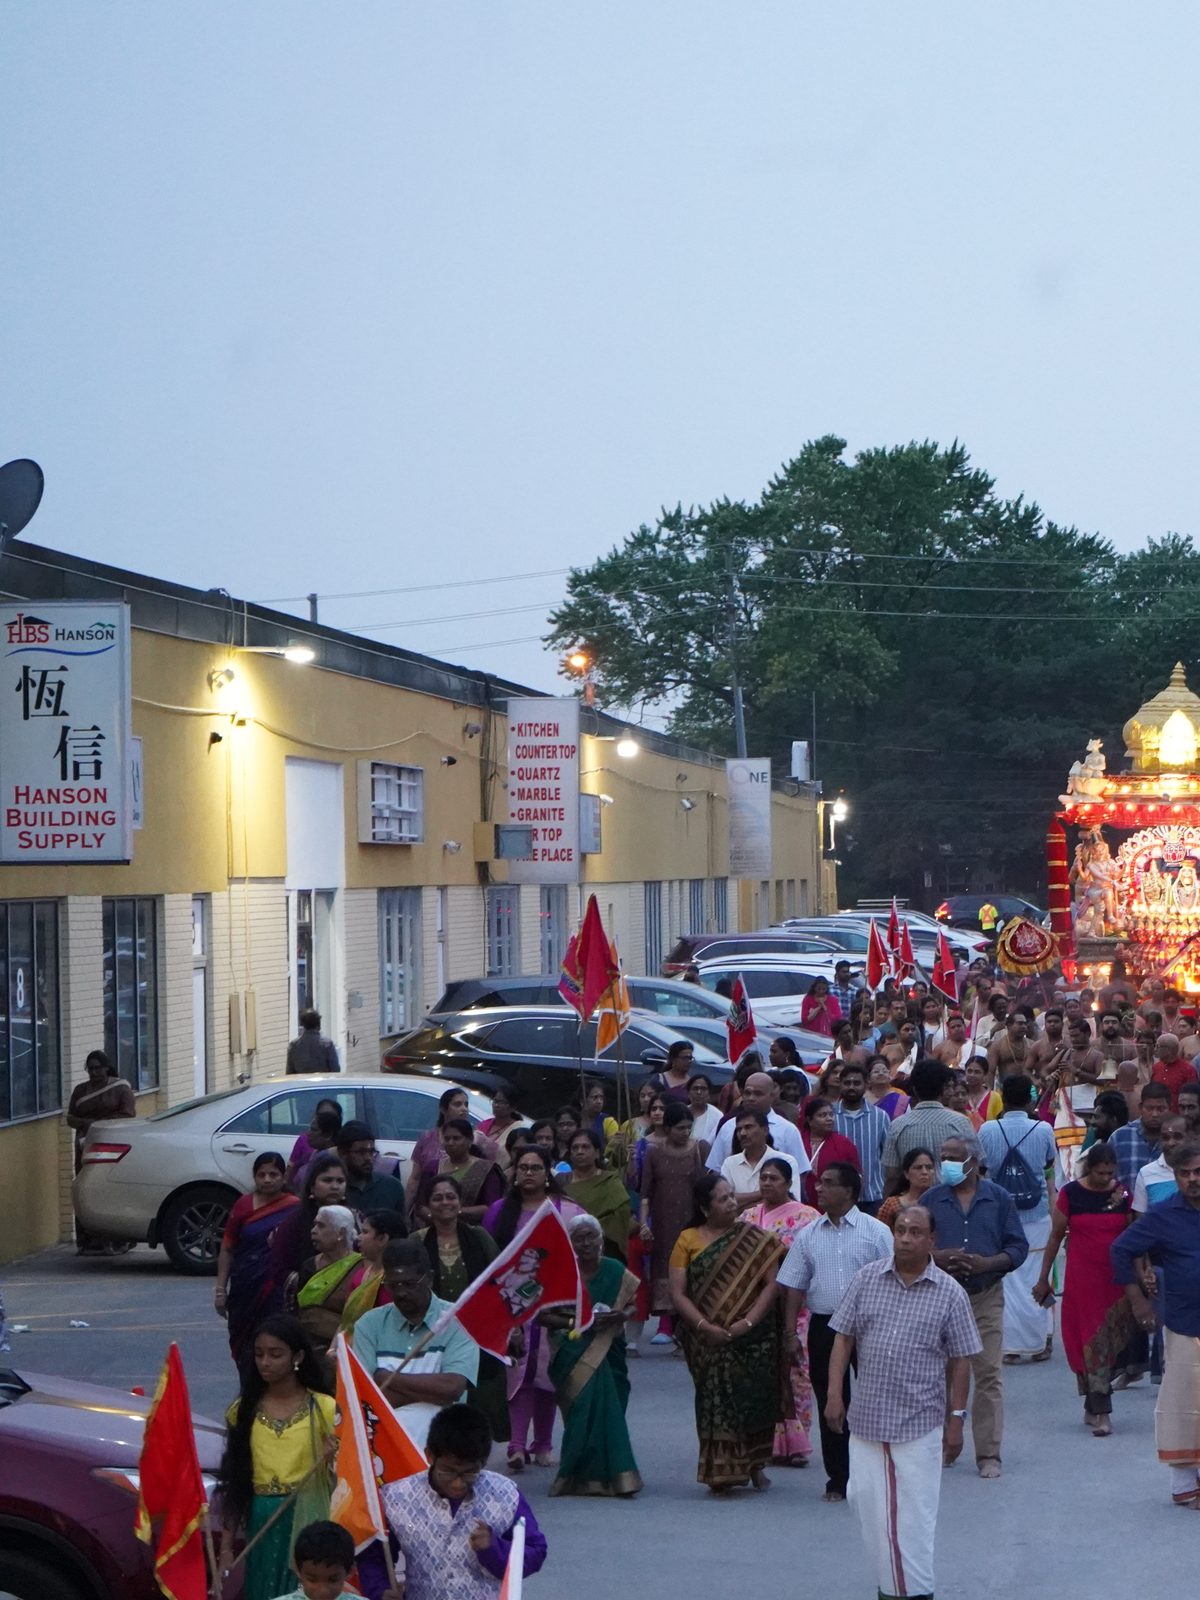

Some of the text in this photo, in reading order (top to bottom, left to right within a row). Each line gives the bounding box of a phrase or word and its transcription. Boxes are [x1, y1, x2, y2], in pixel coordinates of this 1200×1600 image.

[7, 613, 115, 644] HBS HANSON
[517, 723, 559, 737] KITCHEN
[515, 744, 576, 759] COUNTER TOP
[517, 767, 560, 780] QUARTZ
[14, 785, 108, 804] HANSON
[517, 788, 560, 800] MARBLE
[6, 808, 116, 827] BUILDING
[517, 808, 564, 821] GRANITE
[18, 831, 106, 849] SUPPLY
[542, 828, 562, 841] TOP
[541, 849, 573, 861] PLACE
